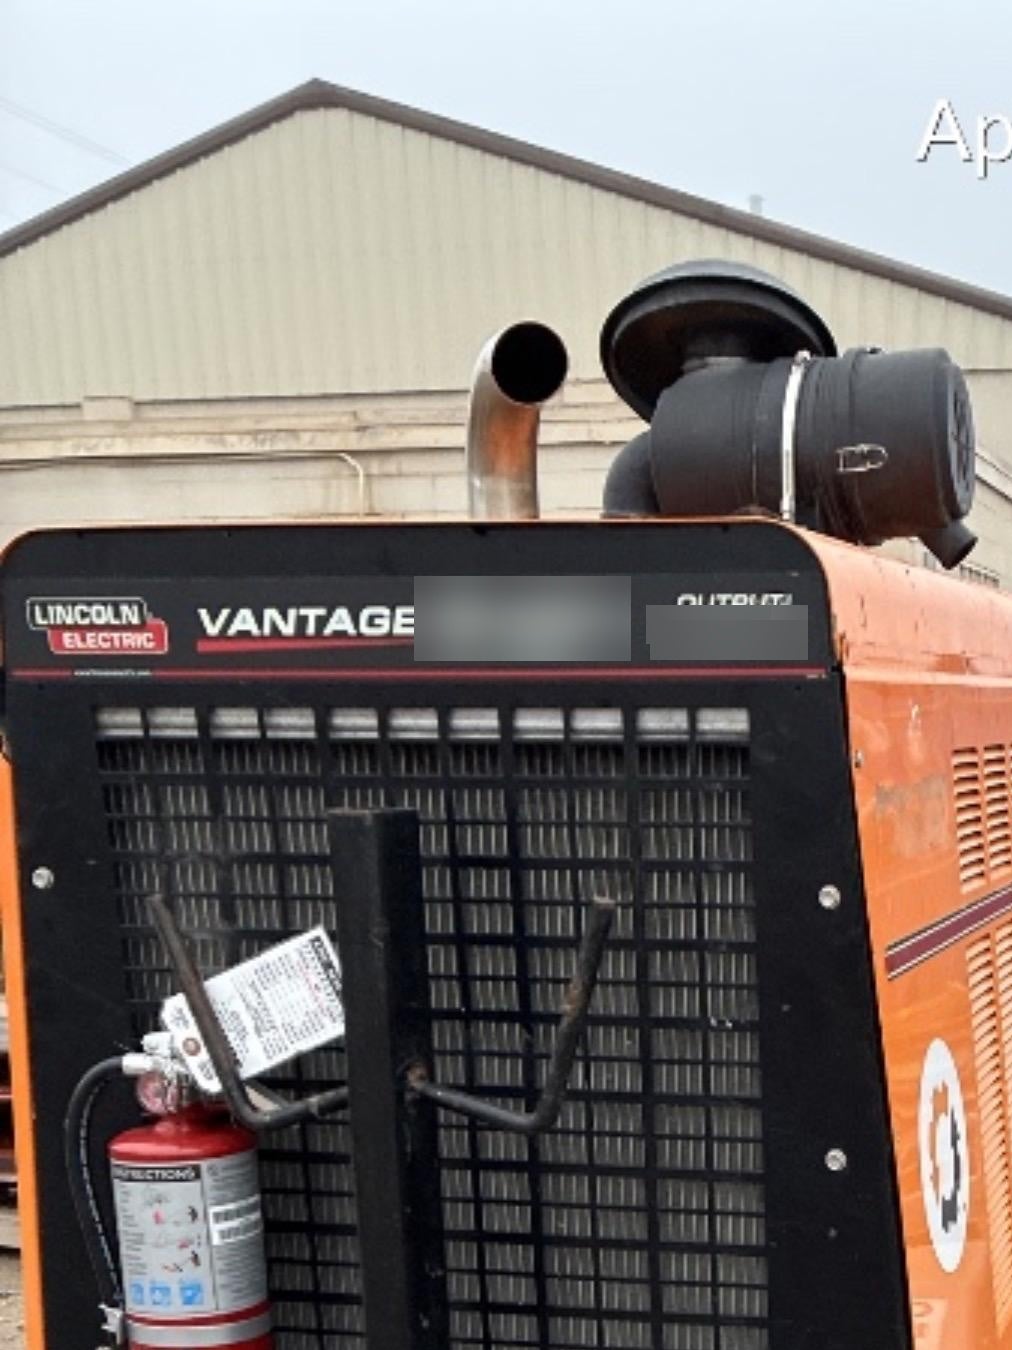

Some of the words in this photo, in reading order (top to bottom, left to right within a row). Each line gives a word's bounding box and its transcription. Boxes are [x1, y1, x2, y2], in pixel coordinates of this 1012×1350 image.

[34, 604, 140, 625] LINCOLN
[198, 606, 414, 636] VANTAGE
[62, 631, 156, 649] ELECTRIC
